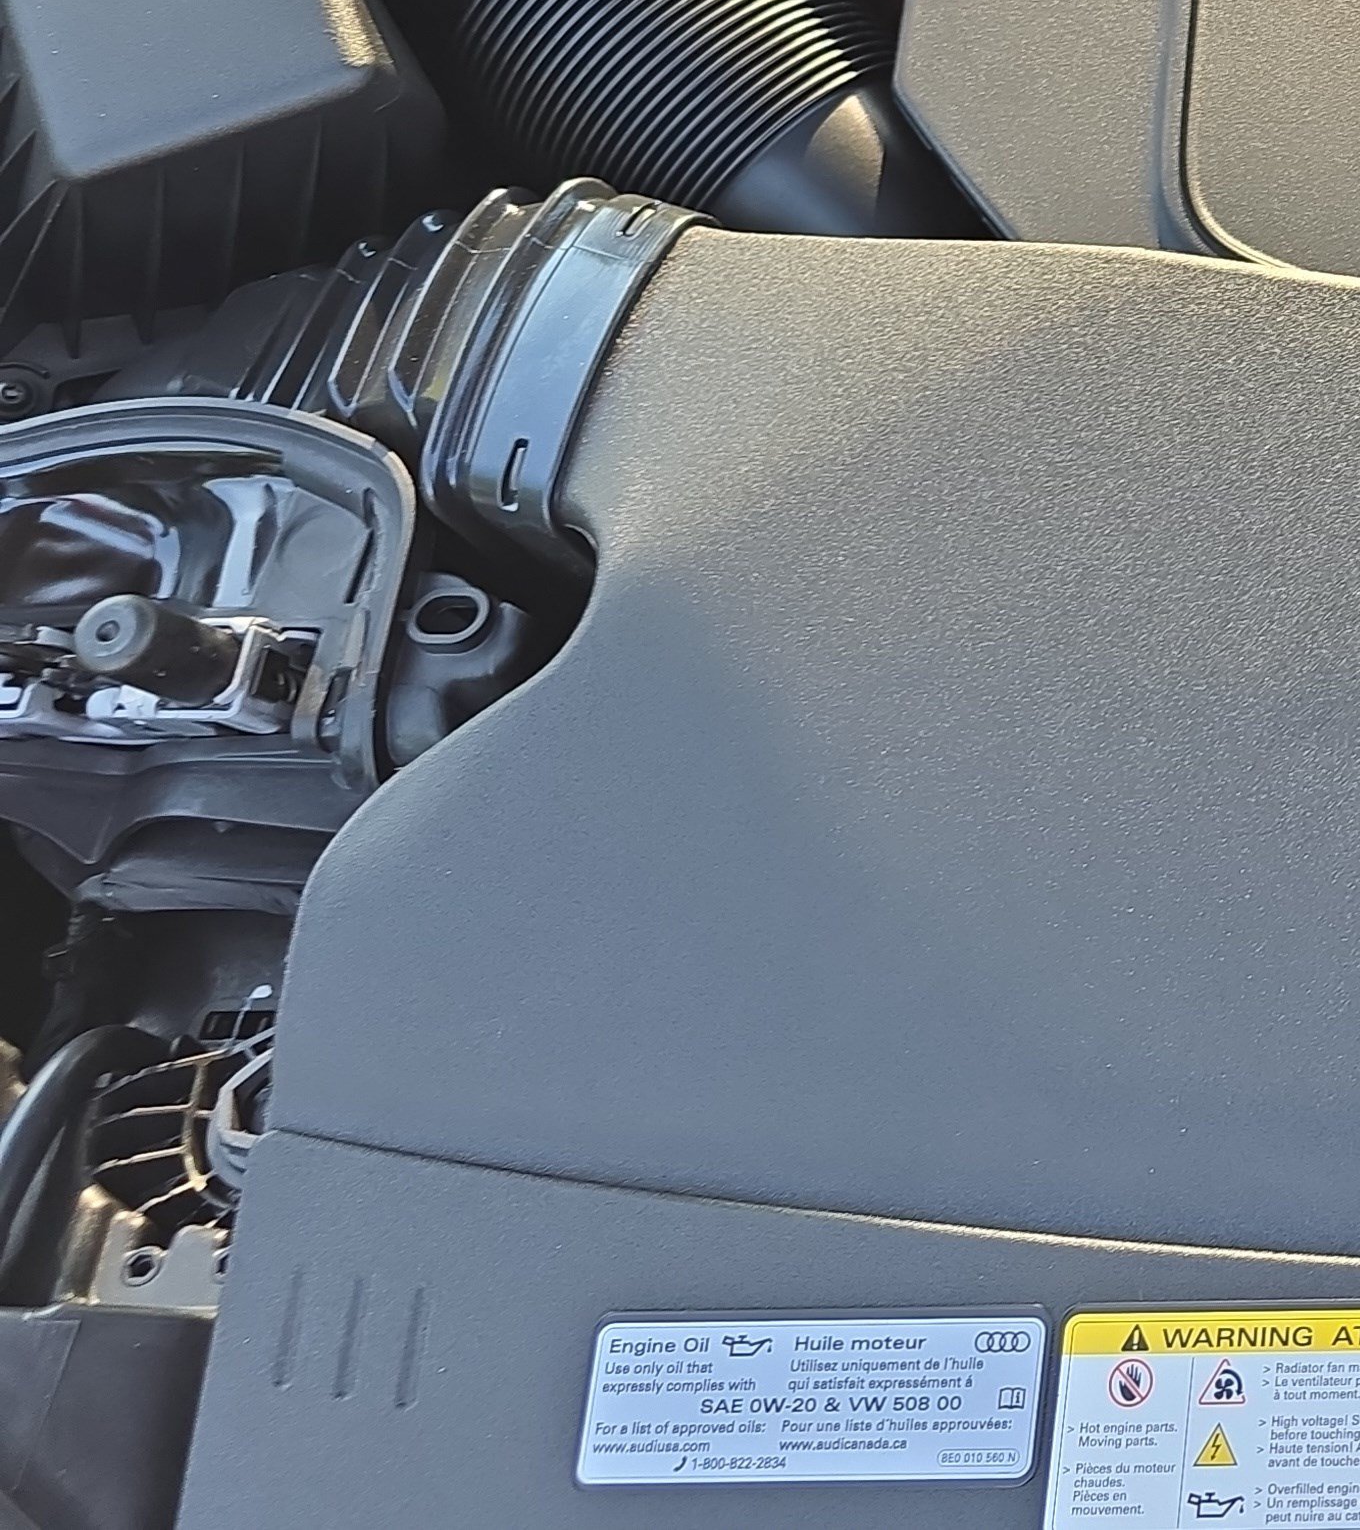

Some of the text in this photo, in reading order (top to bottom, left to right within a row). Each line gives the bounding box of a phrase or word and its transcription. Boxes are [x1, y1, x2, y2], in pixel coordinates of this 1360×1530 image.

[794, 1336, 926, 1351] Huile moteur
[1163, 1327, 1313, 1349] WARNING
[610, 1337, 710, 1356] Engine Oil
[605, 1361, 713, 1377] Use only oil that
[790, 1359, 838, 1372] Utilisez
[841, 1358, 921, 1374] uniquement
[924, 1358, 939, 1370] de
[1276, 1362, 1323, 1373] Radiator
[1327, 1362, 1346, 1373] fan
[603, 1378, 756, 1396] expressly complies with
[788, 1378, 809, 1392] qui
[813, 1377, 865, 1390] satisfait
[869, 1376, 962, 1391] expressément
[1274, 1377, 1288, 1387] Le
[1291, 1375, 1352, 1387] ventilateur
[1273, 1389, 1360, 1400] à tout moment.
[700, 1396, 962, 1414] SAE 0W-20 & VW 508 00
[595, 1420, 766, 1436] For a list of approved oils:
[781, 1420, 813, 1432] Pour
[816, 1422, 840, 1432] une
[845, 1419, 872, 1431] liste
[932, 1418, 1012, 1433] approuvées:
[1080, 1422, 1178, 1435] Hot engine parts.
[1271, 1415, 1298, 1429] High
[1301, 1415, 1348, 1428] voltage!
[1270, 1429, 1307, 1440] before
[1310, 1429, 1360, 1442] touching
[593, 1440, 710, 1453] www.audiusa.com
[779, 1438, 907, 1451] www.audicanada.ca
[1079, 1436, 1158, 1449] Moving parts.
[1269, 1443, 1303, 1454] Haute
[1306, 1442, 1353, 1454] tension!
[691, 1457, 787, 1470] 1-800-822-2834
[1008, 1452, 1016, 1462] N
[1268, 1457, 1300, 1468] avant
[1303, 1456, 1317, 1467] de
[1075, 1463, 1176, 1474] Pièces du moteur
[1074, 1476, 1126, 1488] chaudes.
[1267, 1483, 1324, 1495] Overfilled
[1073, 1490, 1127, 1502] Pièces en
[1267, 1498, 1284, 1508] Un
[1287, 1497, 1358, 1510] remplissage
[1071, 1505, 1145, 1516] mouvement.
[1265, 1512, 1291, 1525] peut
[1294, 1511, 1325, 1522] nuire
[1327, 1512, 1342, 1521] au
